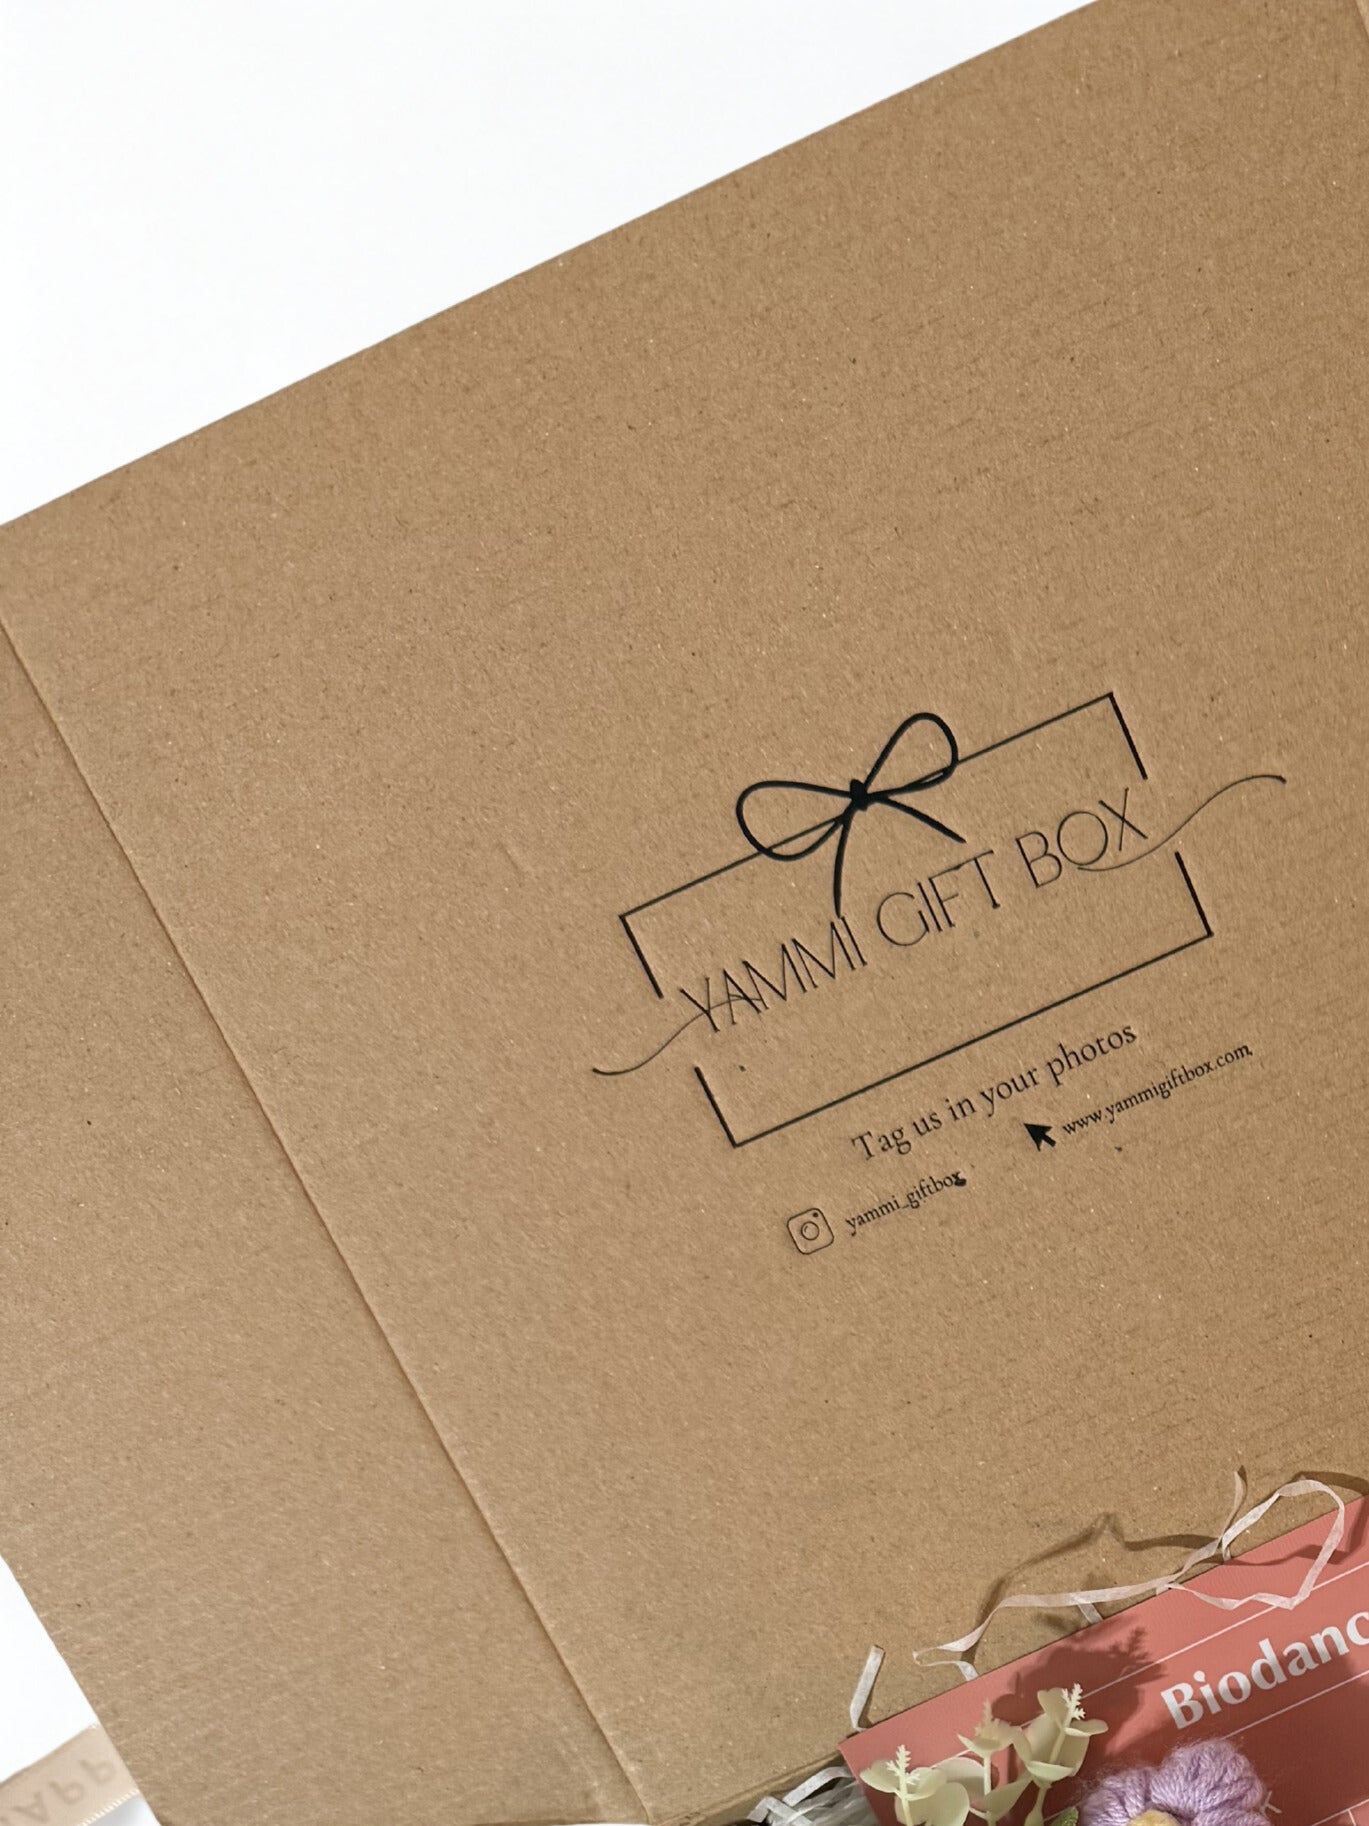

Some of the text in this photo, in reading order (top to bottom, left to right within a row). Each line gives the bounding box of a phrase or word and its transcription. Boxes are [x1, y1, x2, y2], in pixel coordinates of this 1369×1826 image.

[680, 787, 1149, 1033] YAMMI GIFT BOX
[850, 1022, 1138, 1162] Tag us in your photos
[1061, 1041, 1254, 1139] www.yammigiftbox.com
